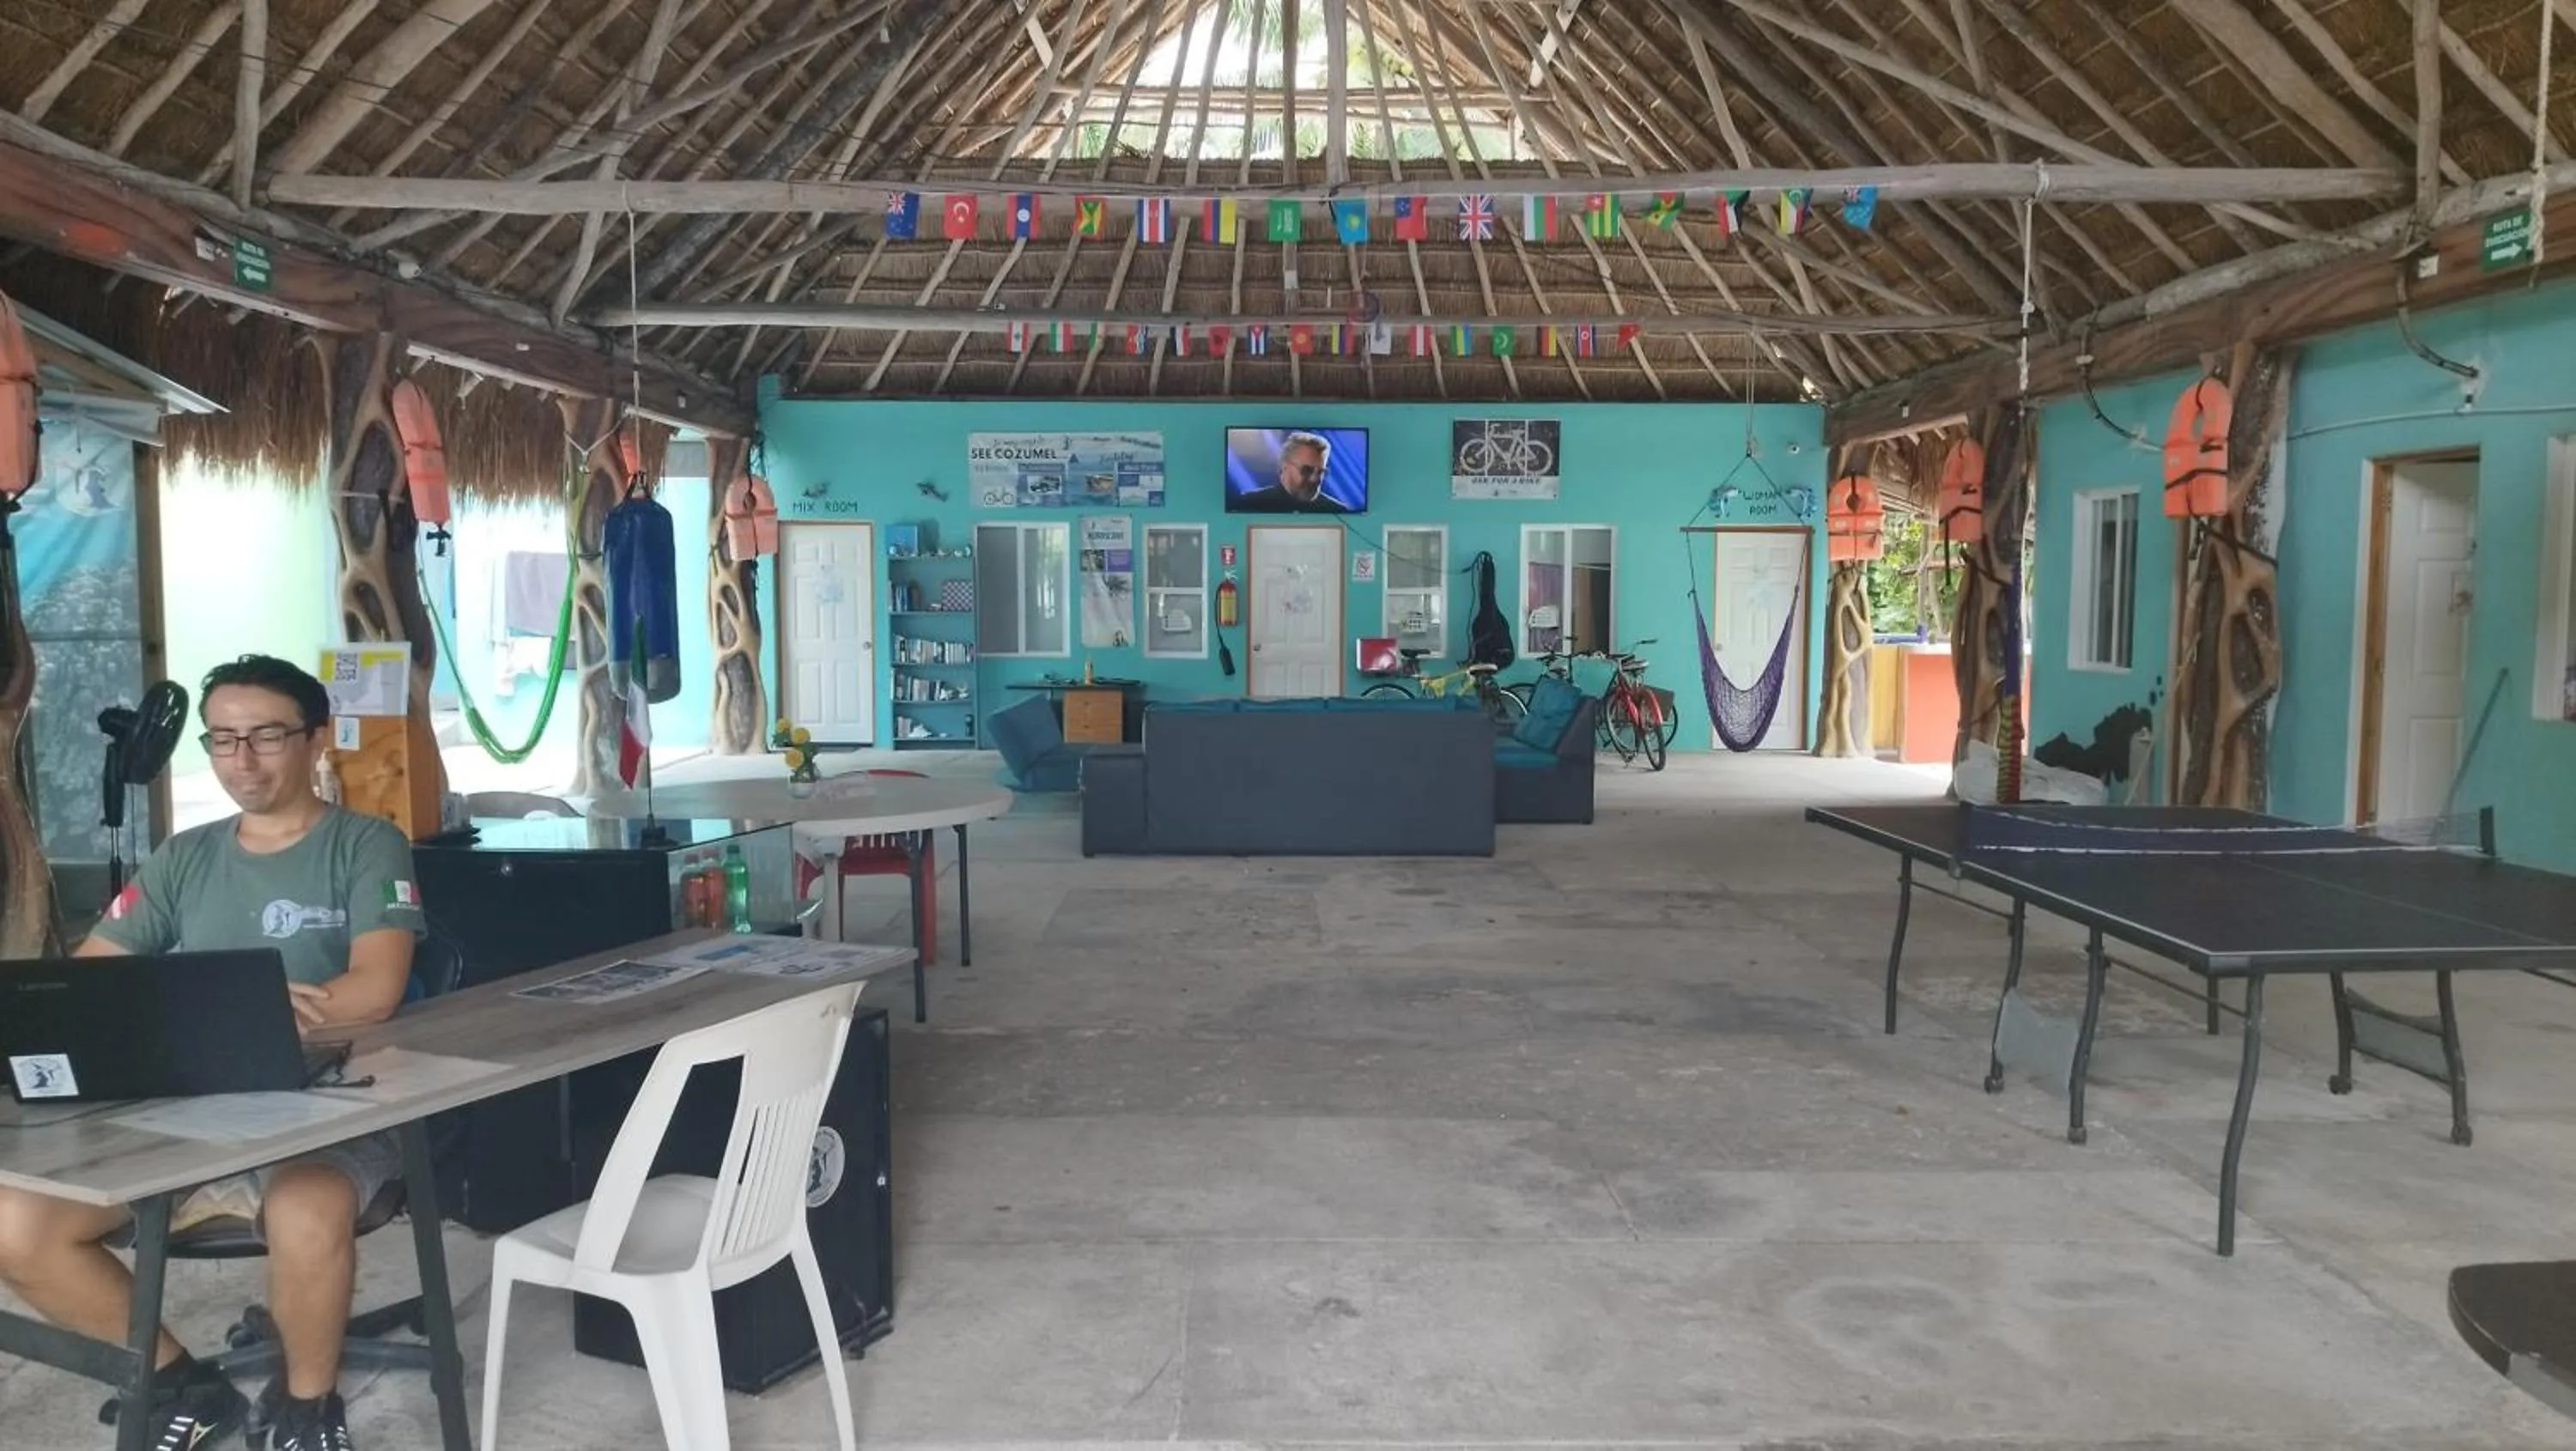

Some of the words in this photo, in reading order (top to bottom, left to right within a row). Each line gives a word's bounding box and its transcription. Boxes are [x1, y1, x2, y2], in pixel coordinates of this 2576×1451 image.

[971, 447, 993, 459] SEE
[994, 447, 1057, 459] COZUMEL
[793, 501, 814, 513] MIX
[825, 501, 858, 513] ROOM
[1749, 505, 1777, 515] ROOM
